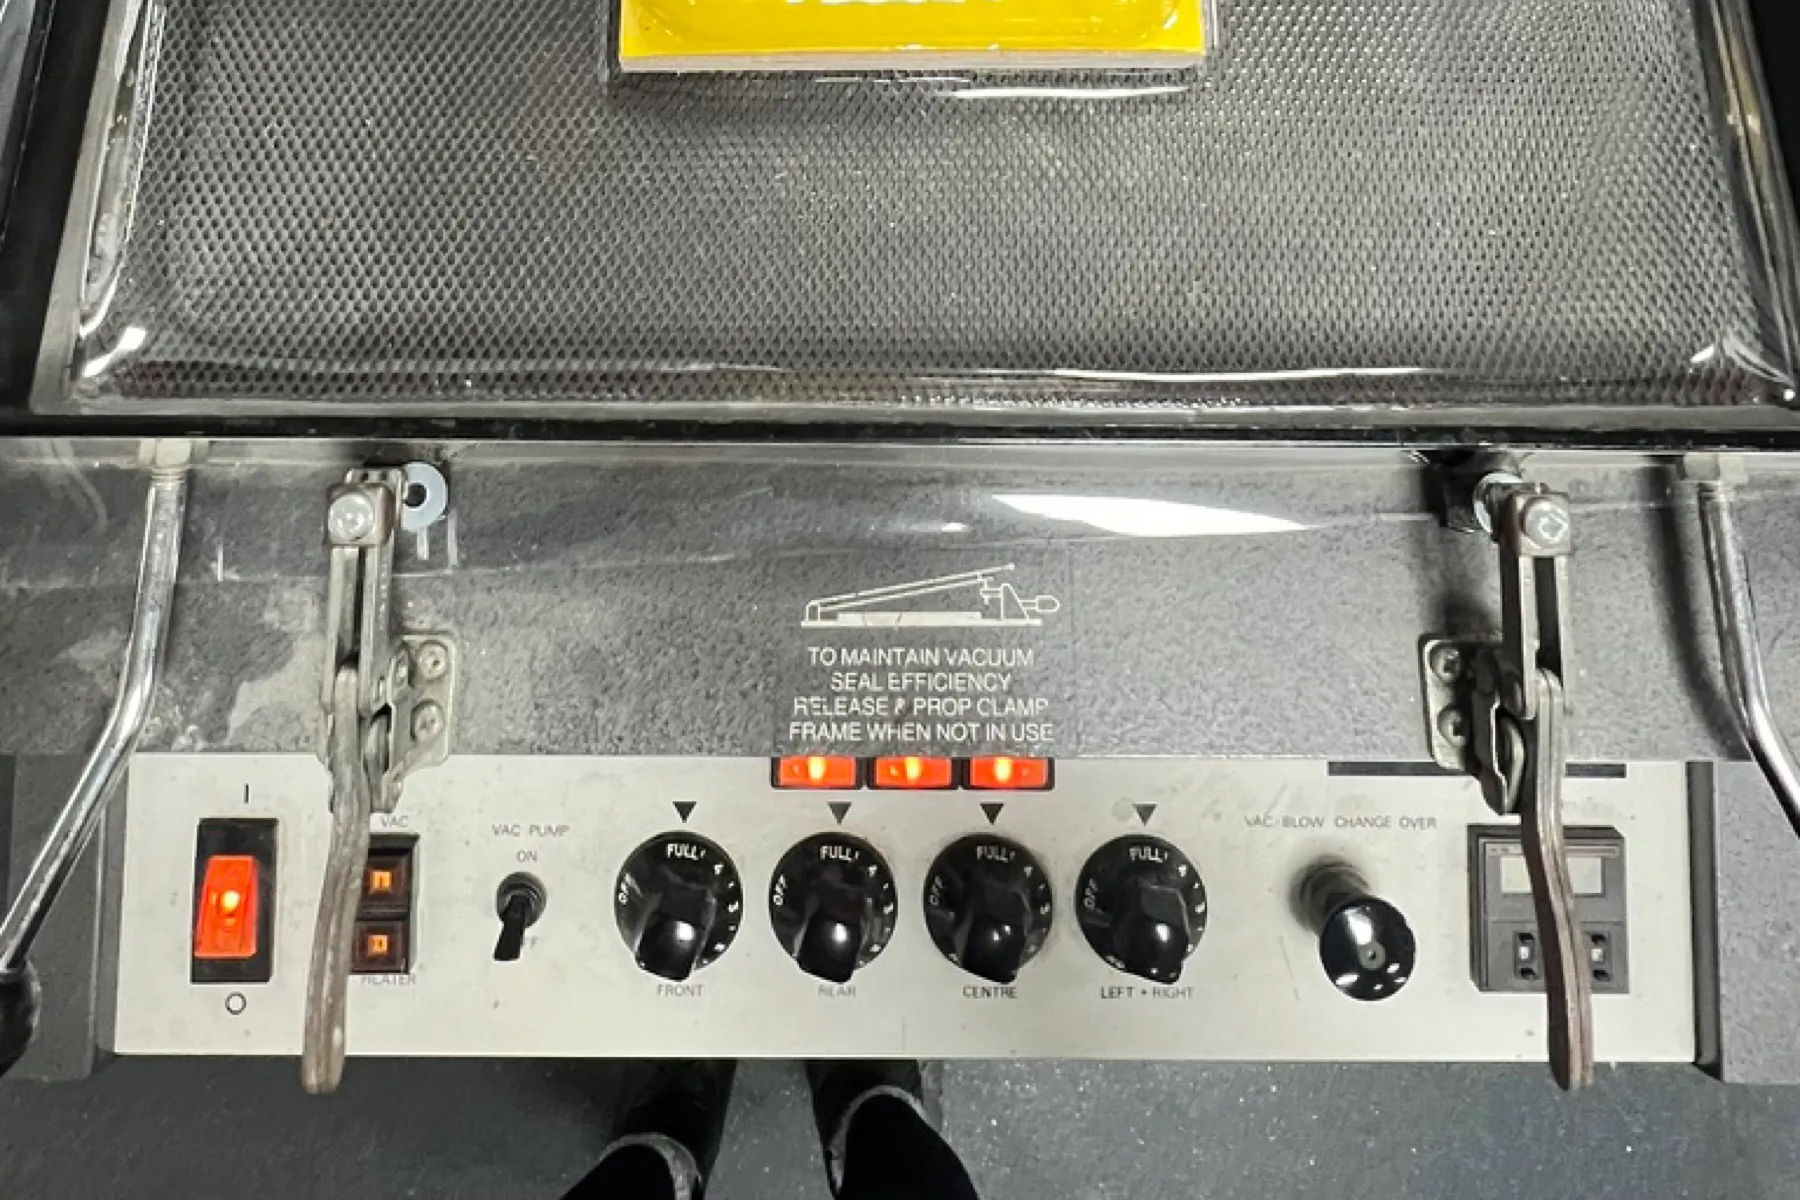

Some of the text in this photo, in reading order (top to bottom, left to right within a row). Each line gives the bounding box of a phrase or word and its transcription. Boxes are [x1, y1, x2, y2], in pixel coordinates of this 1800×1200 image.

[808, 646, 1034, 667] TO MAINTAIN VACUUM
[831, 672, 1011, 692] SEAL EFFICIENCY
[793, 696, 889, 716] RELEASE
[913, 698, 971, 716] PROP
[977, 698, 1048, 717] CLAMP
[789, 721, 1054, 742] FRAME WHEN NOT IN USE
[380, 814, 409, 828] VAC
[1334, 814, 1391, 829] CHANGE
[1399, 815, 1438, 830] OVER
[492, 824, 570, 837] VAC PUMP
[516, 849, 538, 862] ON
[657, 983, 704, 997] FRONT
[817, 984, 856, 997] REAR
[962, 986, 1018, 999] CENTRE
[1100, 986, 1134, 1000] LEFT
[1153, 986, 1195, 1000] RIGHT
